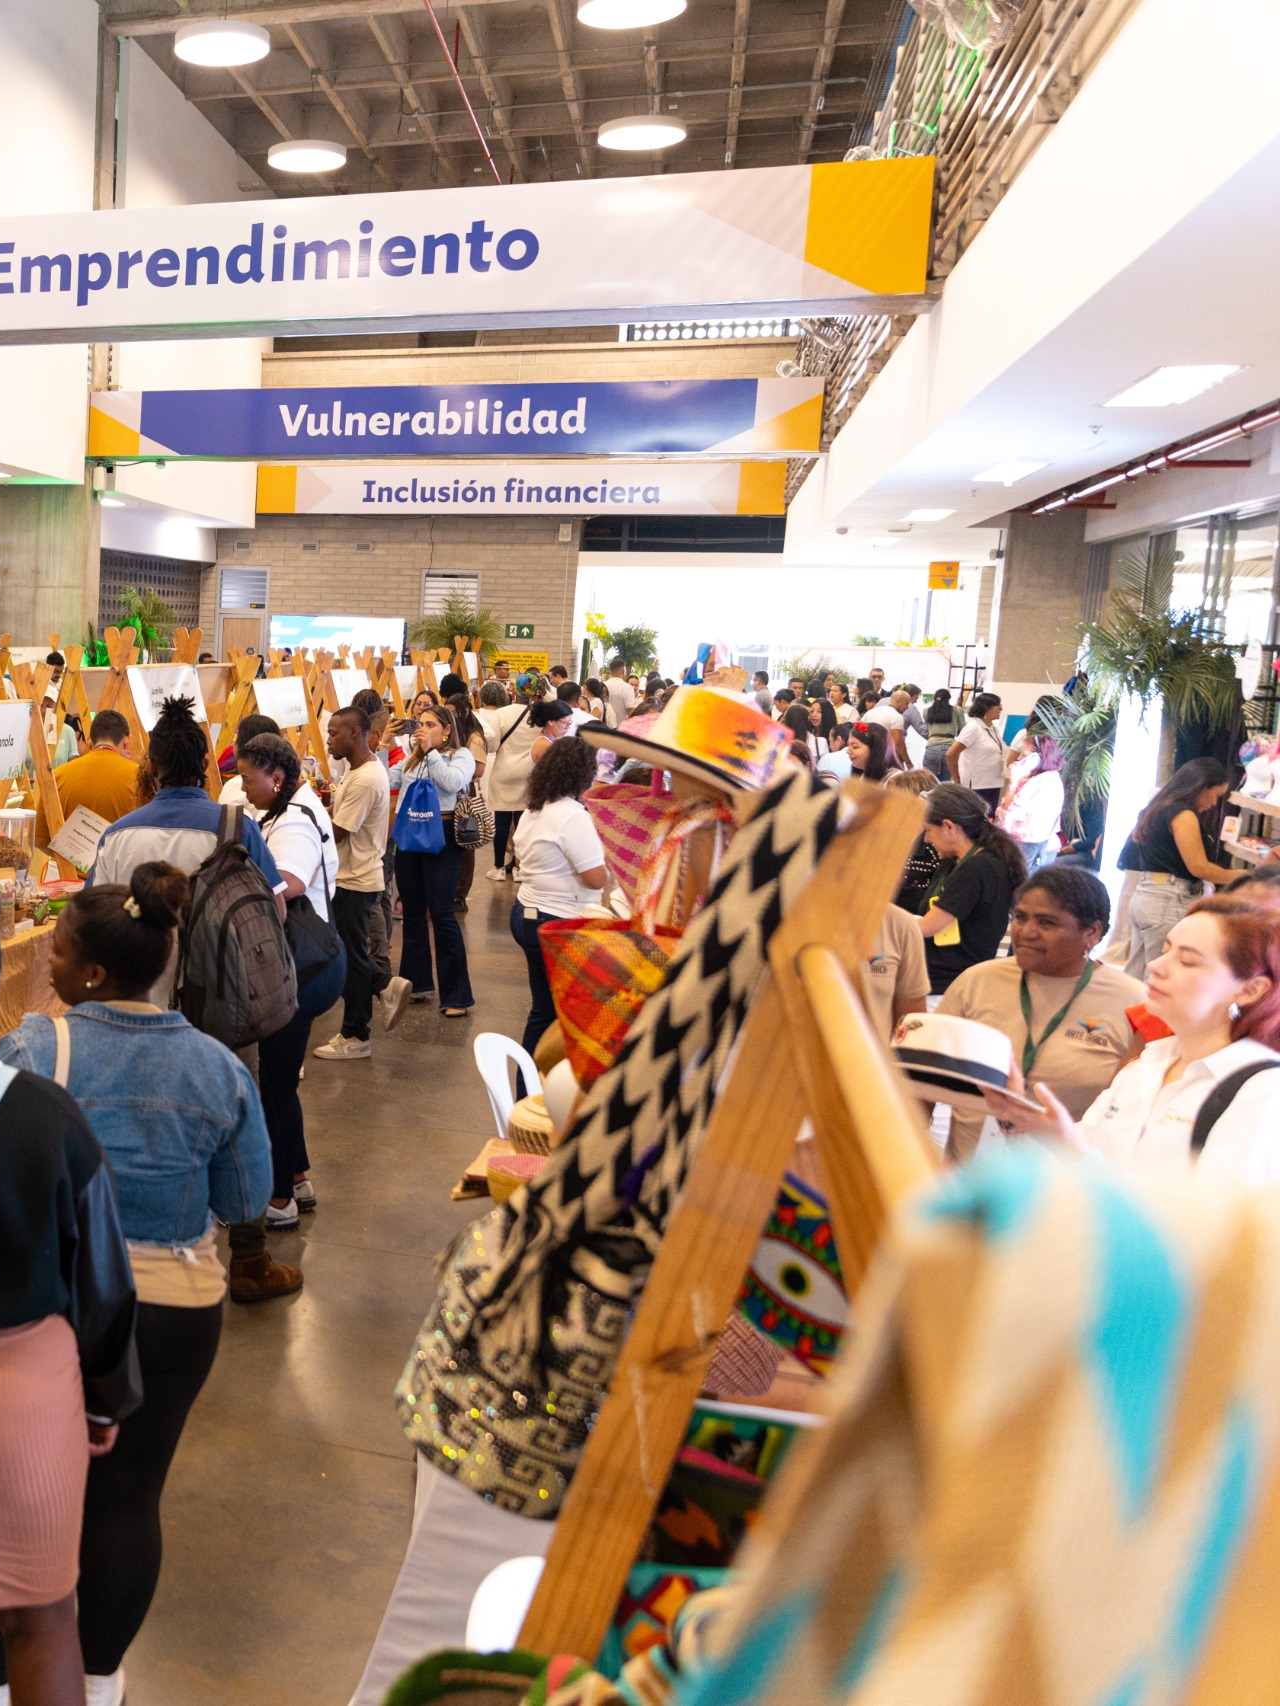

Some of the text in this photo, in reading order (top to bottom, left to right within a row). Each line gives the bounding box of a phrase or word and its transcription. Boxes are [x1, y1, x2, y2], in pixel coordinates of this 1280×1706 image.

[279, 397, 587, 437] Vulnerabilidad
[361, 478, 661, 505] Inclusión financiera
